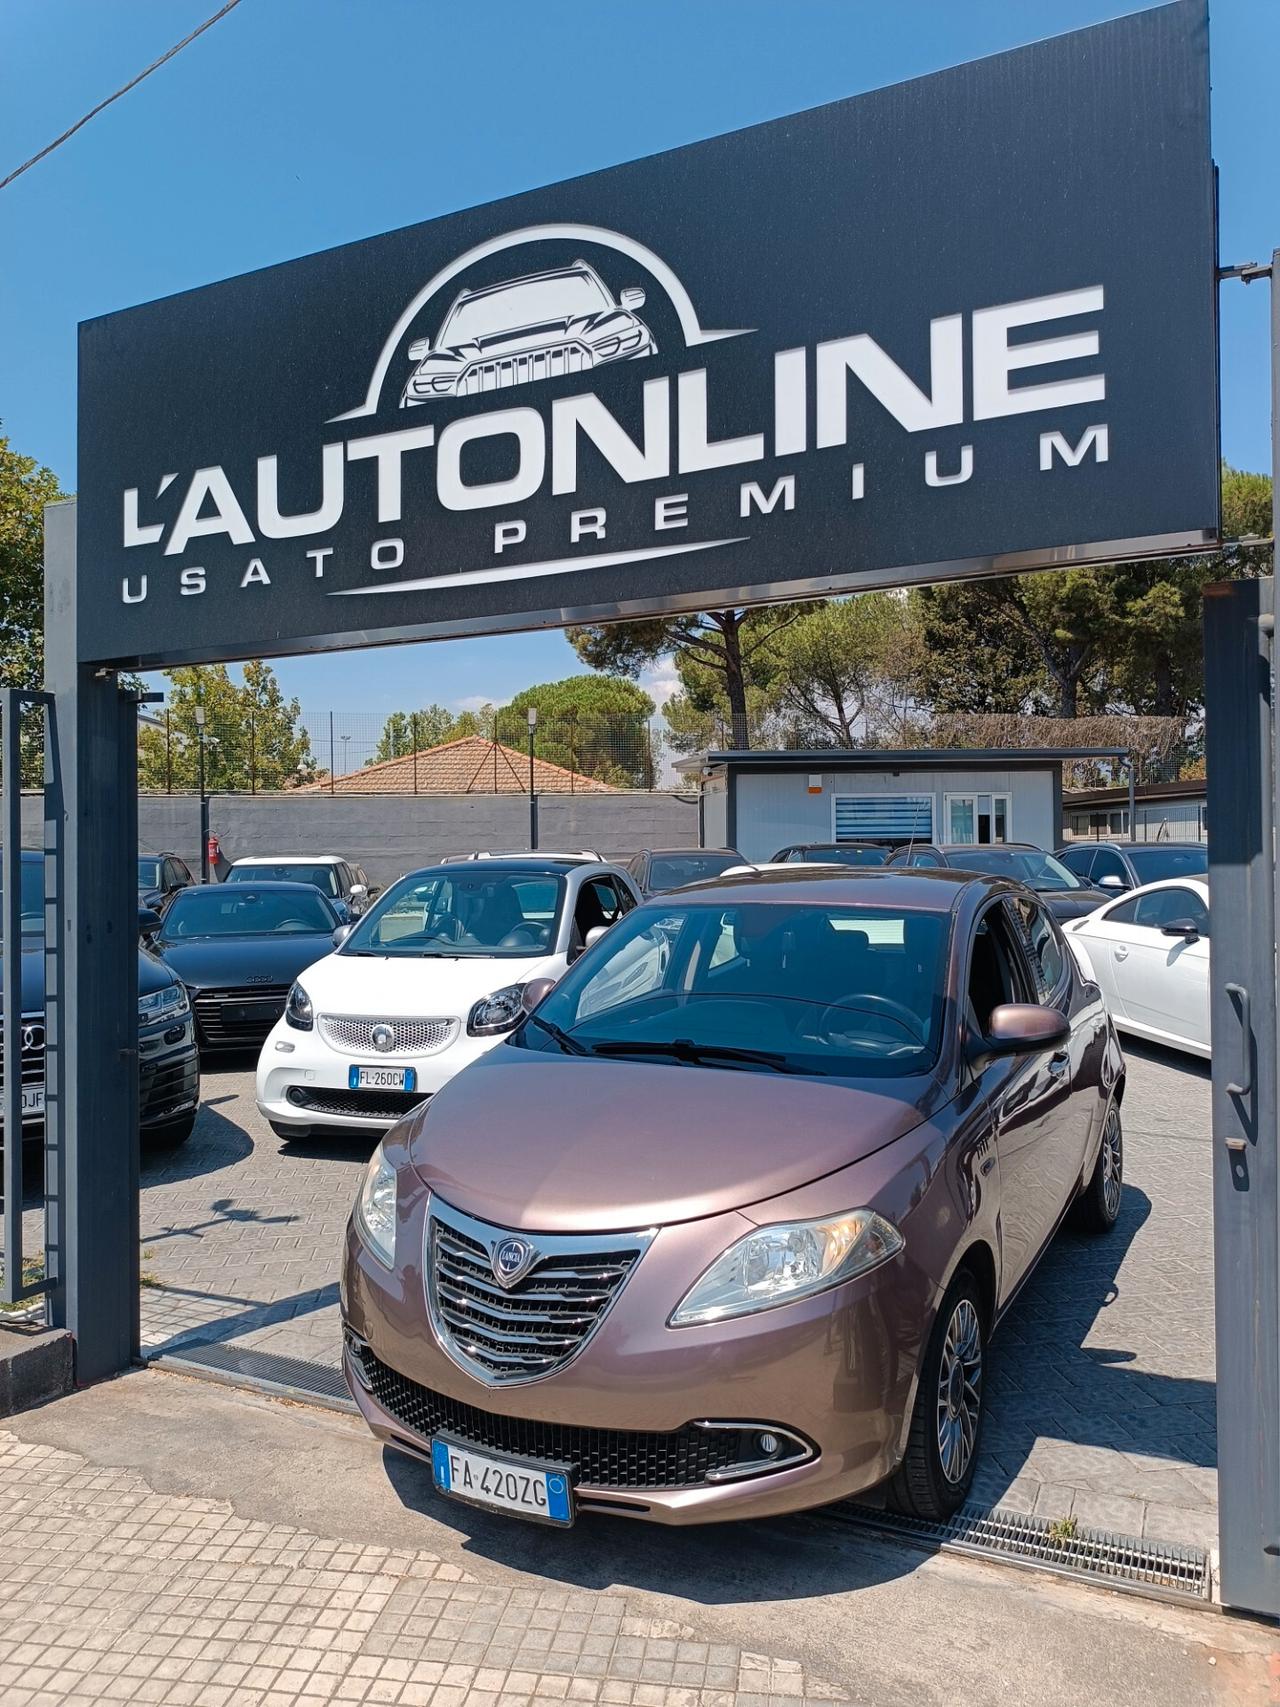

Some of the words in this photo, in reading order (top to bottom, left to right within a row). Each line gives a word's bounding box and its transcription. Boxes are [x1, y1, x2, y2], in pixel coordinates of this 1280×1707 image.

[122, 284, 1106, 556] L'AUTONLINE
[121, 538, 405, 605] USATO
[493, 423, 1110, 554] PREMIUM
[501, 1250, 520, 1263] LANCIA
